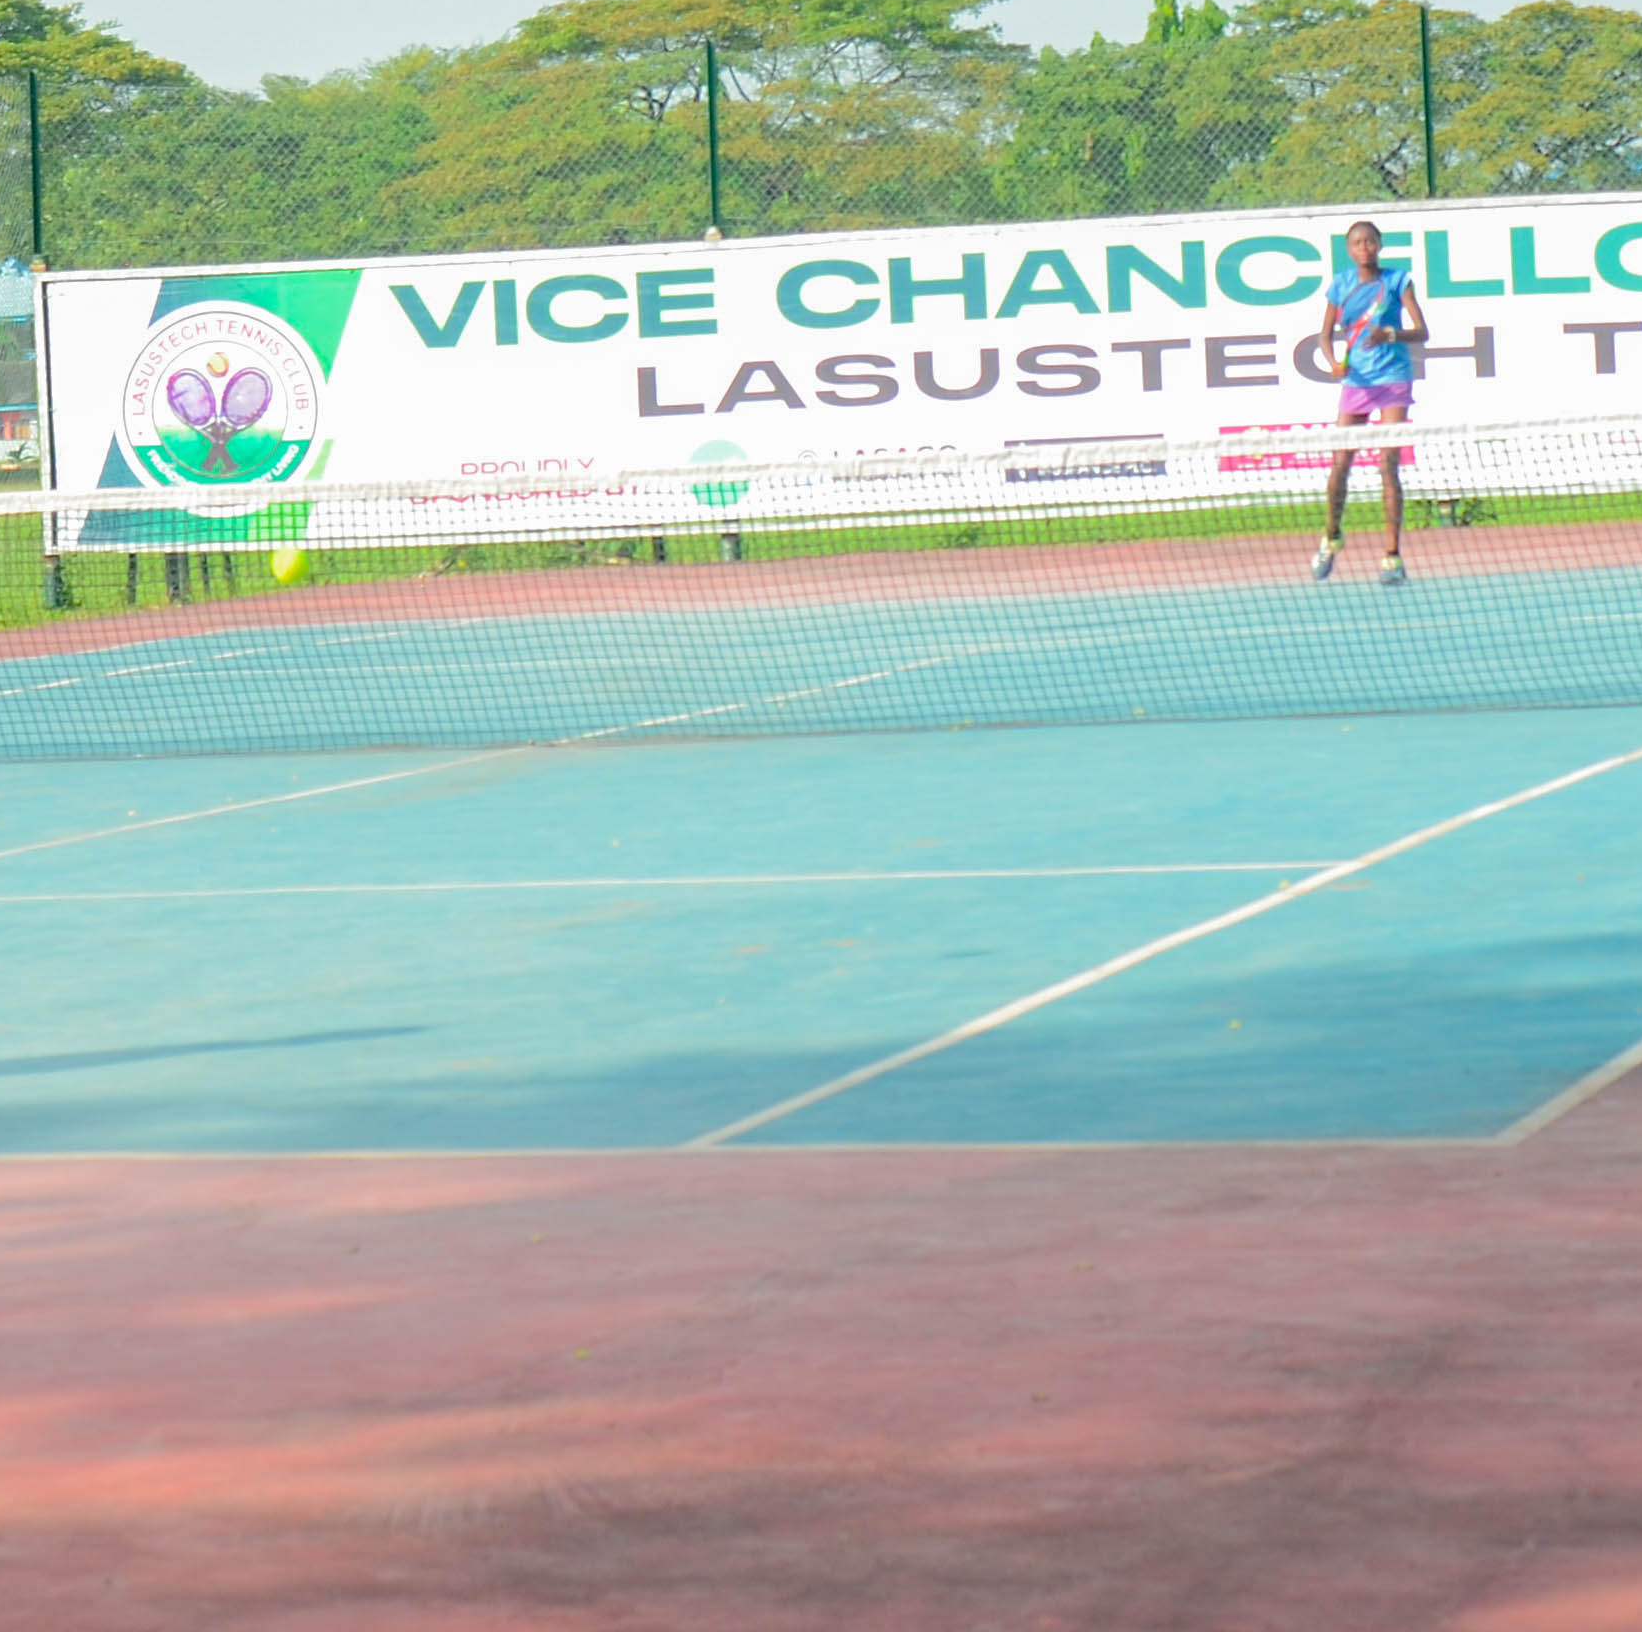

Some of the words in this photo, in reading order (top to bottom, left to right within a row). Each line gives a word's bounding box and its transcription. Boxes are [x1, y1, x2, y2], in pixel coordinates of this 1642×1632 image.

[389, 267, 719, 349] VICE
[133, 321, 207, 416] LASUSTECH
[217, 320, 283, 356] TENNIS
[283, 357, 310, 411] CLUB
